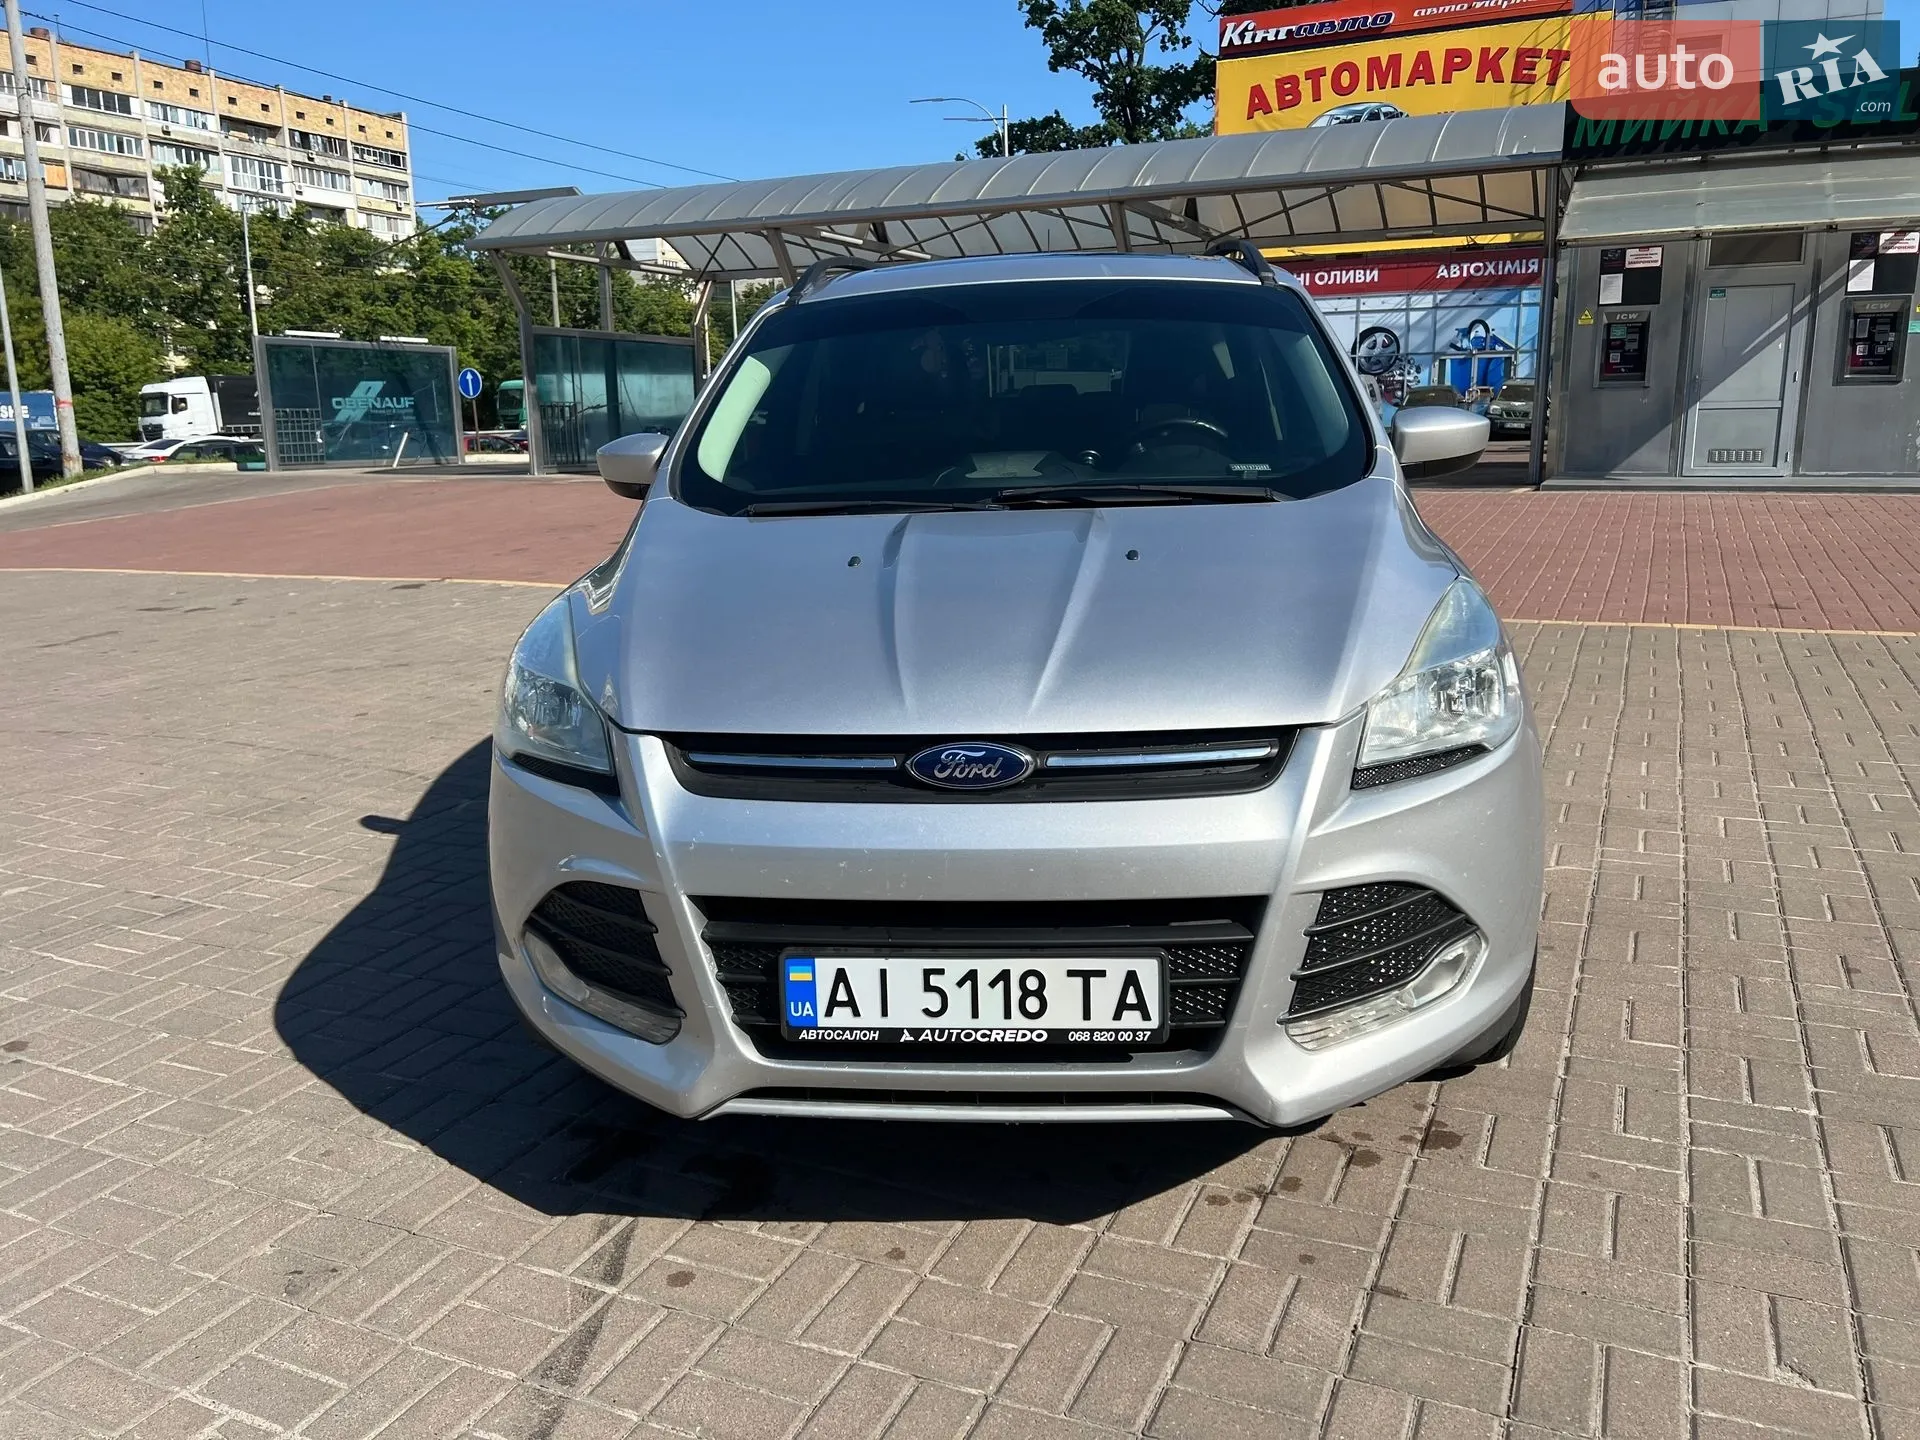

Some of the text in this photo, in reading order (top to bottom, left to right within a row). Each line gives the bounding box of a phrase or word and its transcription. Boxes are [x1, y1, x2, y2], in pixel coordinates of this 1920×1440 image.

[1220, 11, 1396, 48] Кінгавто
[1246, 46, 1571, 121] АВТОМАРКЕТ
[1314, 267, 1379, 286] ОЛИВИ
[1436, 258, 1539, 279] АВТОХІМІЯ
[331, 396, 415, 409] OBENAUF
[933, 749, 1003, 779] Ford
[921, 968, 1048, 1021] 5118
[1066, 969, 1153, 1022] TA
[790, 1002, 815, 1018] UA
[798, 1029, 880, 1041] АВТОСАЛОН
[918, 1029, 1048, 1043] AUTOCREDO
[1068, 1031, 1151, 1042] 068 820 00 37
